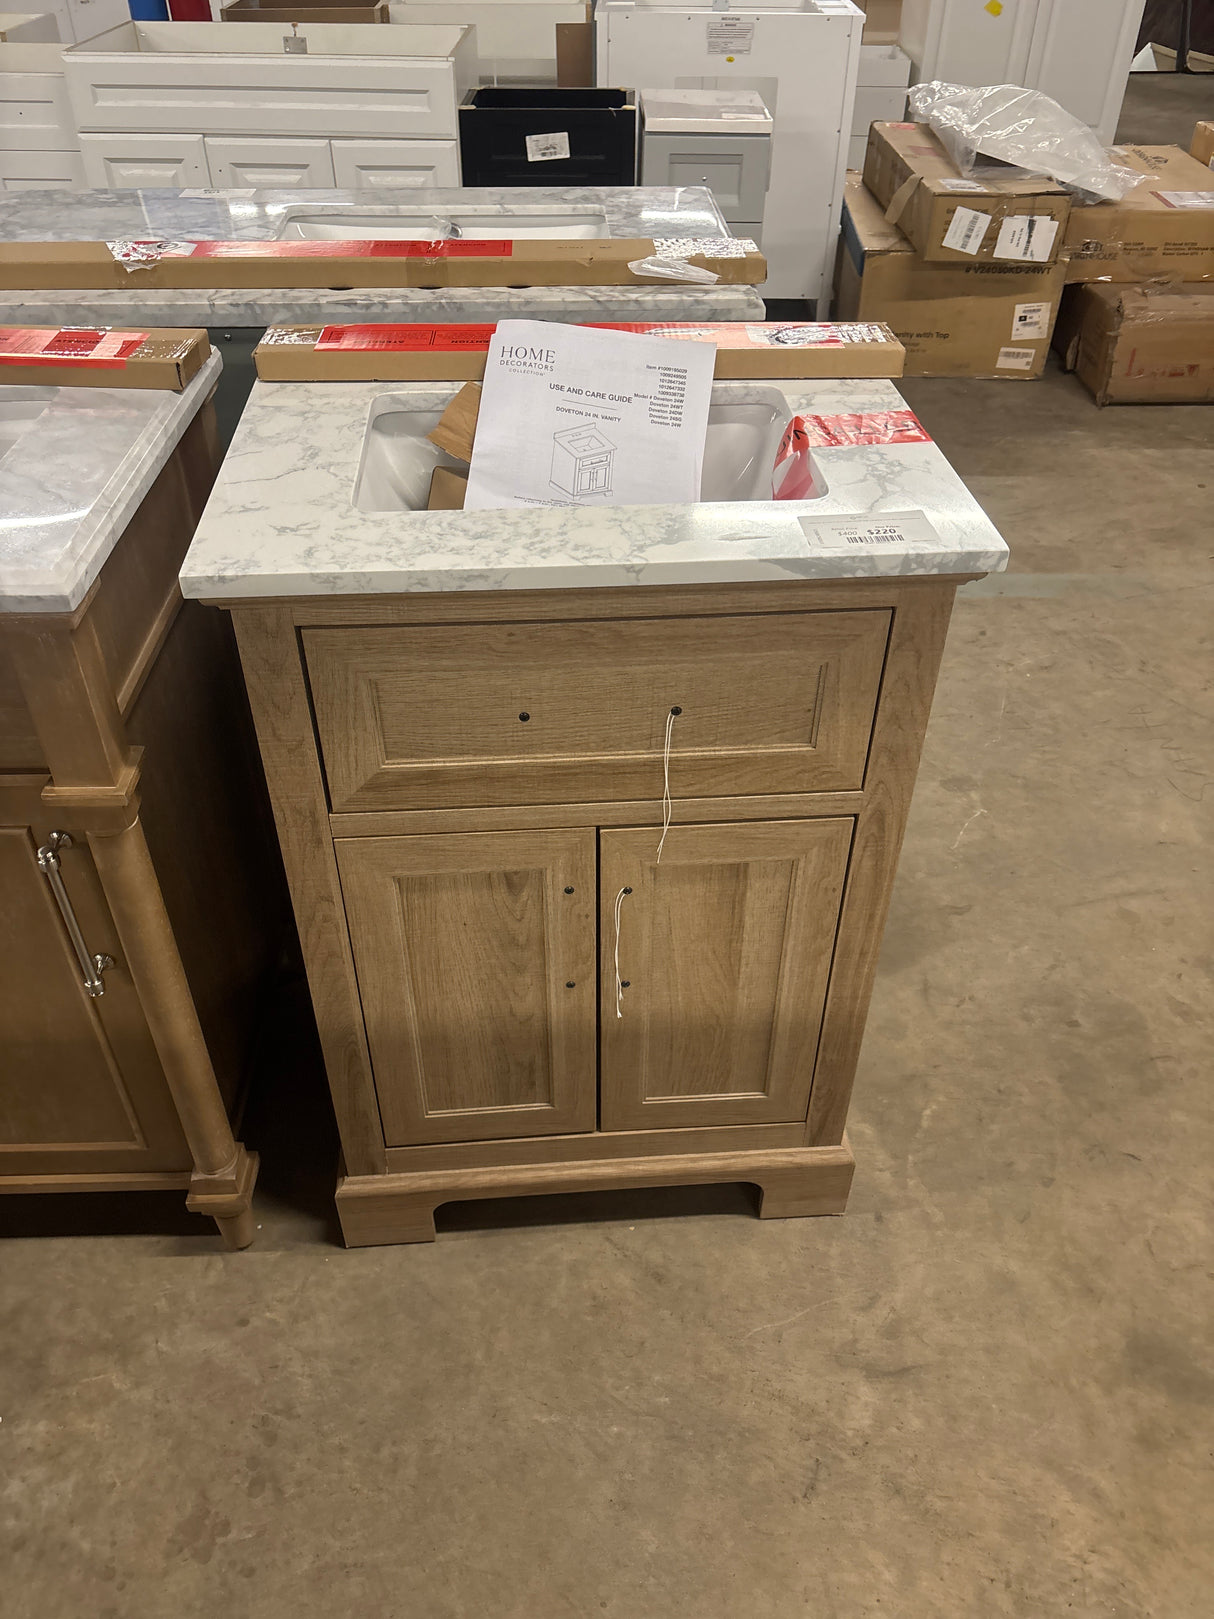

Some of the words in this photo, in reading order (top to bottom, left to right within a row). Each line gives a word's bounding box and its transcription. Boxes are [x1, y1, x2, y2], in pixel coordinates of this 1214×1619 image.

[935, 331, 950, 340] Top
[501, 346, 556, 364] HOME
[500, 360, 554, 372] DECORATORS
[509, 368, 544, 376] COLLECTION
[549, 383, 565, 392] USE
[566, 387, 584, 396] AND
[585, 390, 607, 400] CARE
[608, 394, 633, 404] GUIDE
[653, 395, 673, 403] Doveton
[555, 406, 584, 416] DOVETON
[600, 414, 622, 423] VANITY
[650, 419, 670, 427] Doveton
[866, 528, 897, 536] $220
